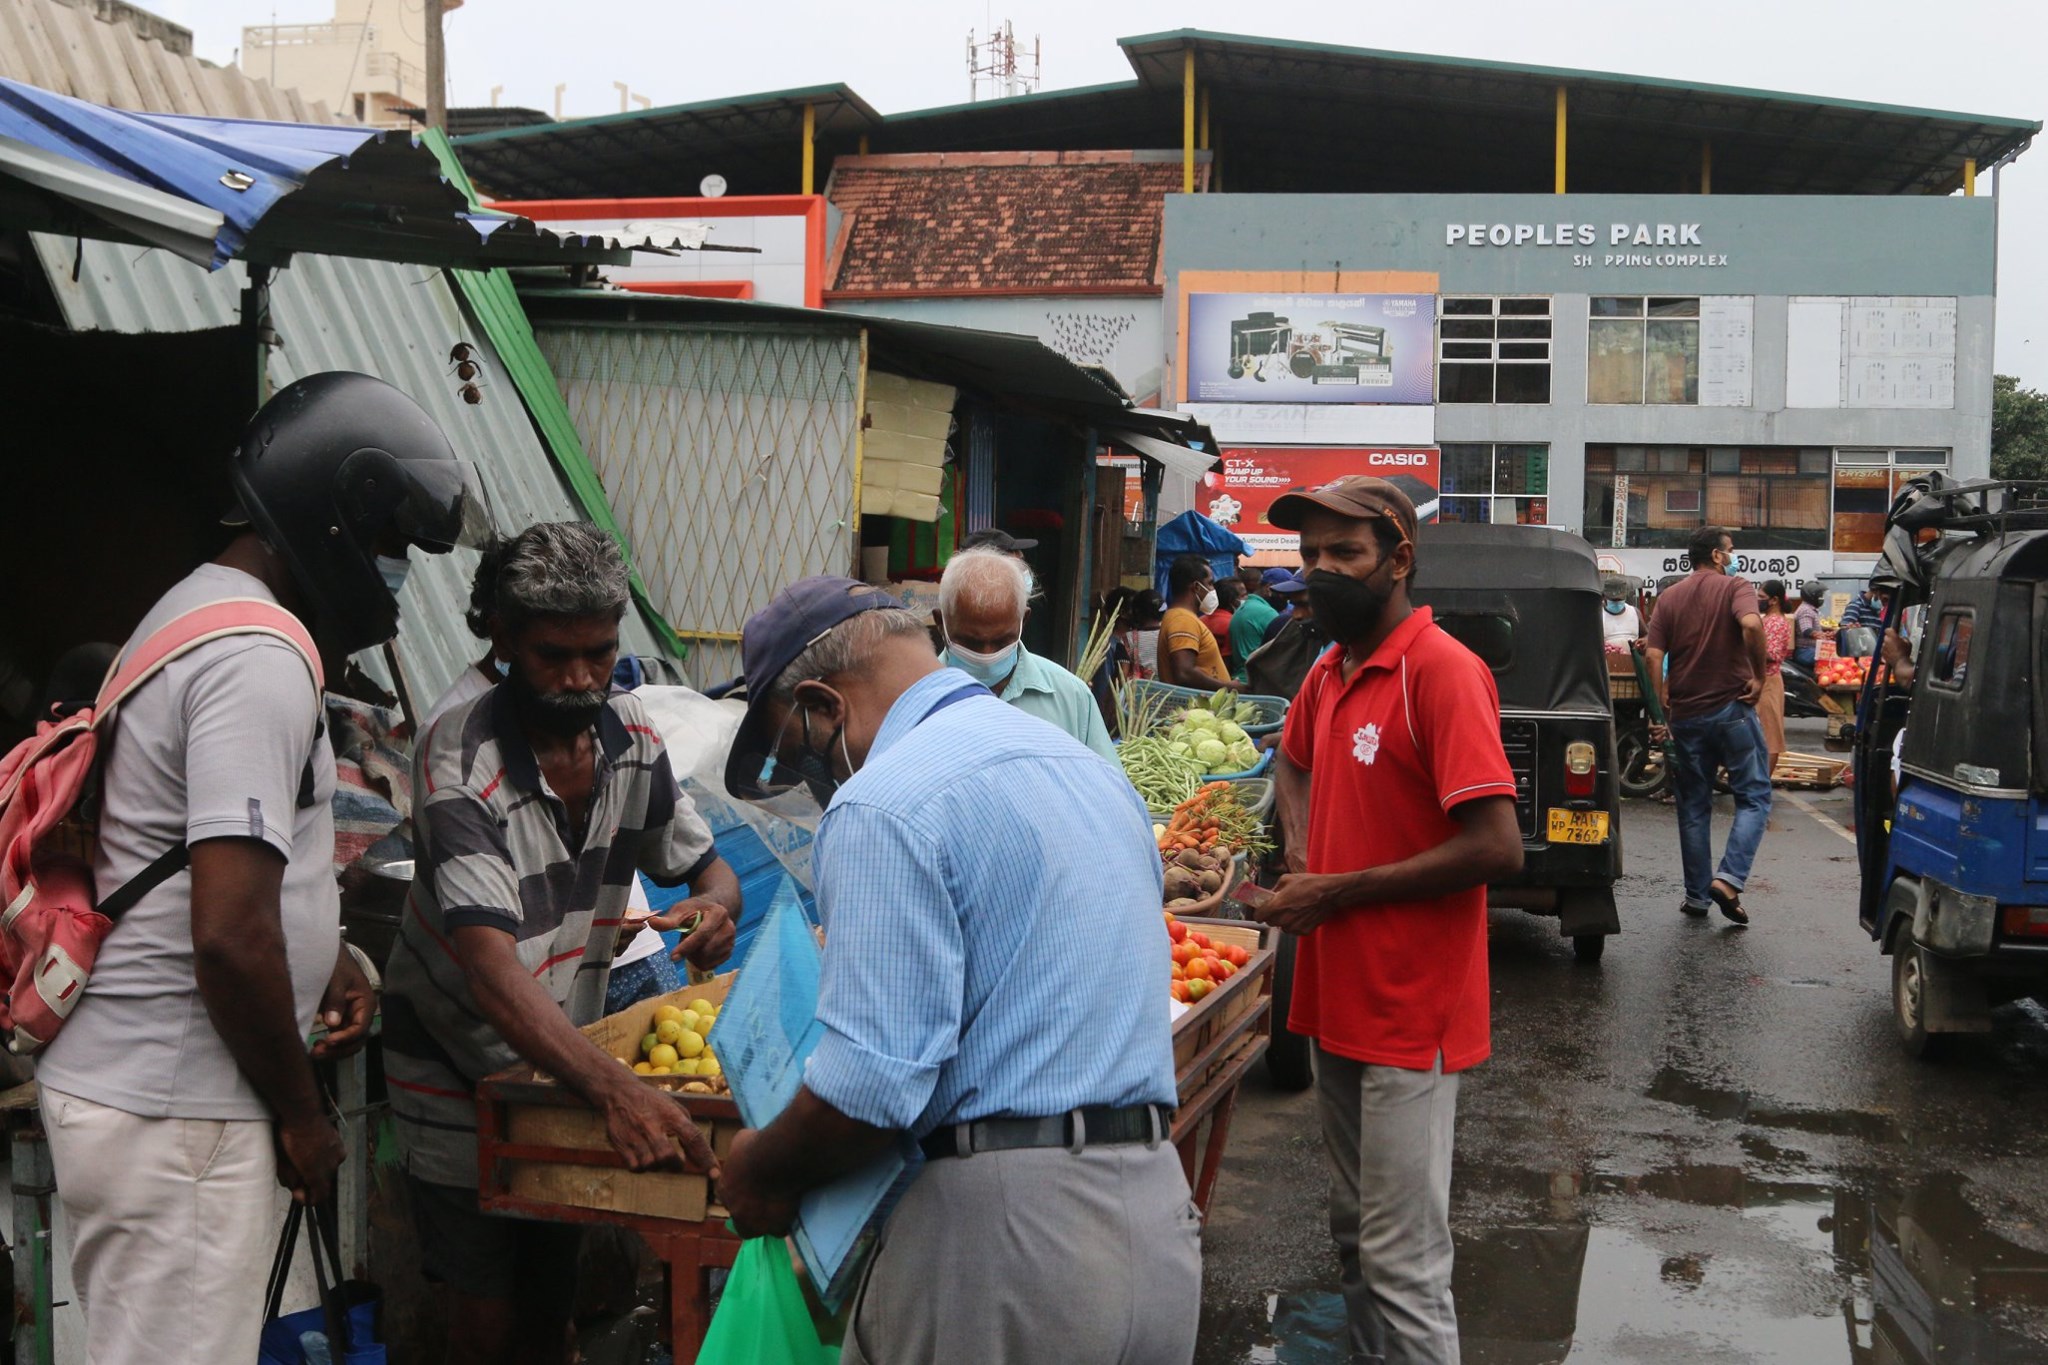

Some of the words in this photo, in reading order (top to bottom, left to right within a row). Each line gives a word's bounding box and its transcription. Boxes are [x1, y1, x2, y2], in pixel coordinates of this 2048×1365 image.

[1446, 223, 1596, 246] PEOPLES
[1610, 224, 1701, 246] PARK
[1655, 254, 1728, 266] COMPLEX
[1390, 299, 1416, 307] YAMAHA
[1225, 459, 1254, 468] CT-X
[1368, 453, 1427, 465] CASIO
[1225, 475, 1248, 483] YOUR
[1838, 470, 1884, 479] CRYSTAL
